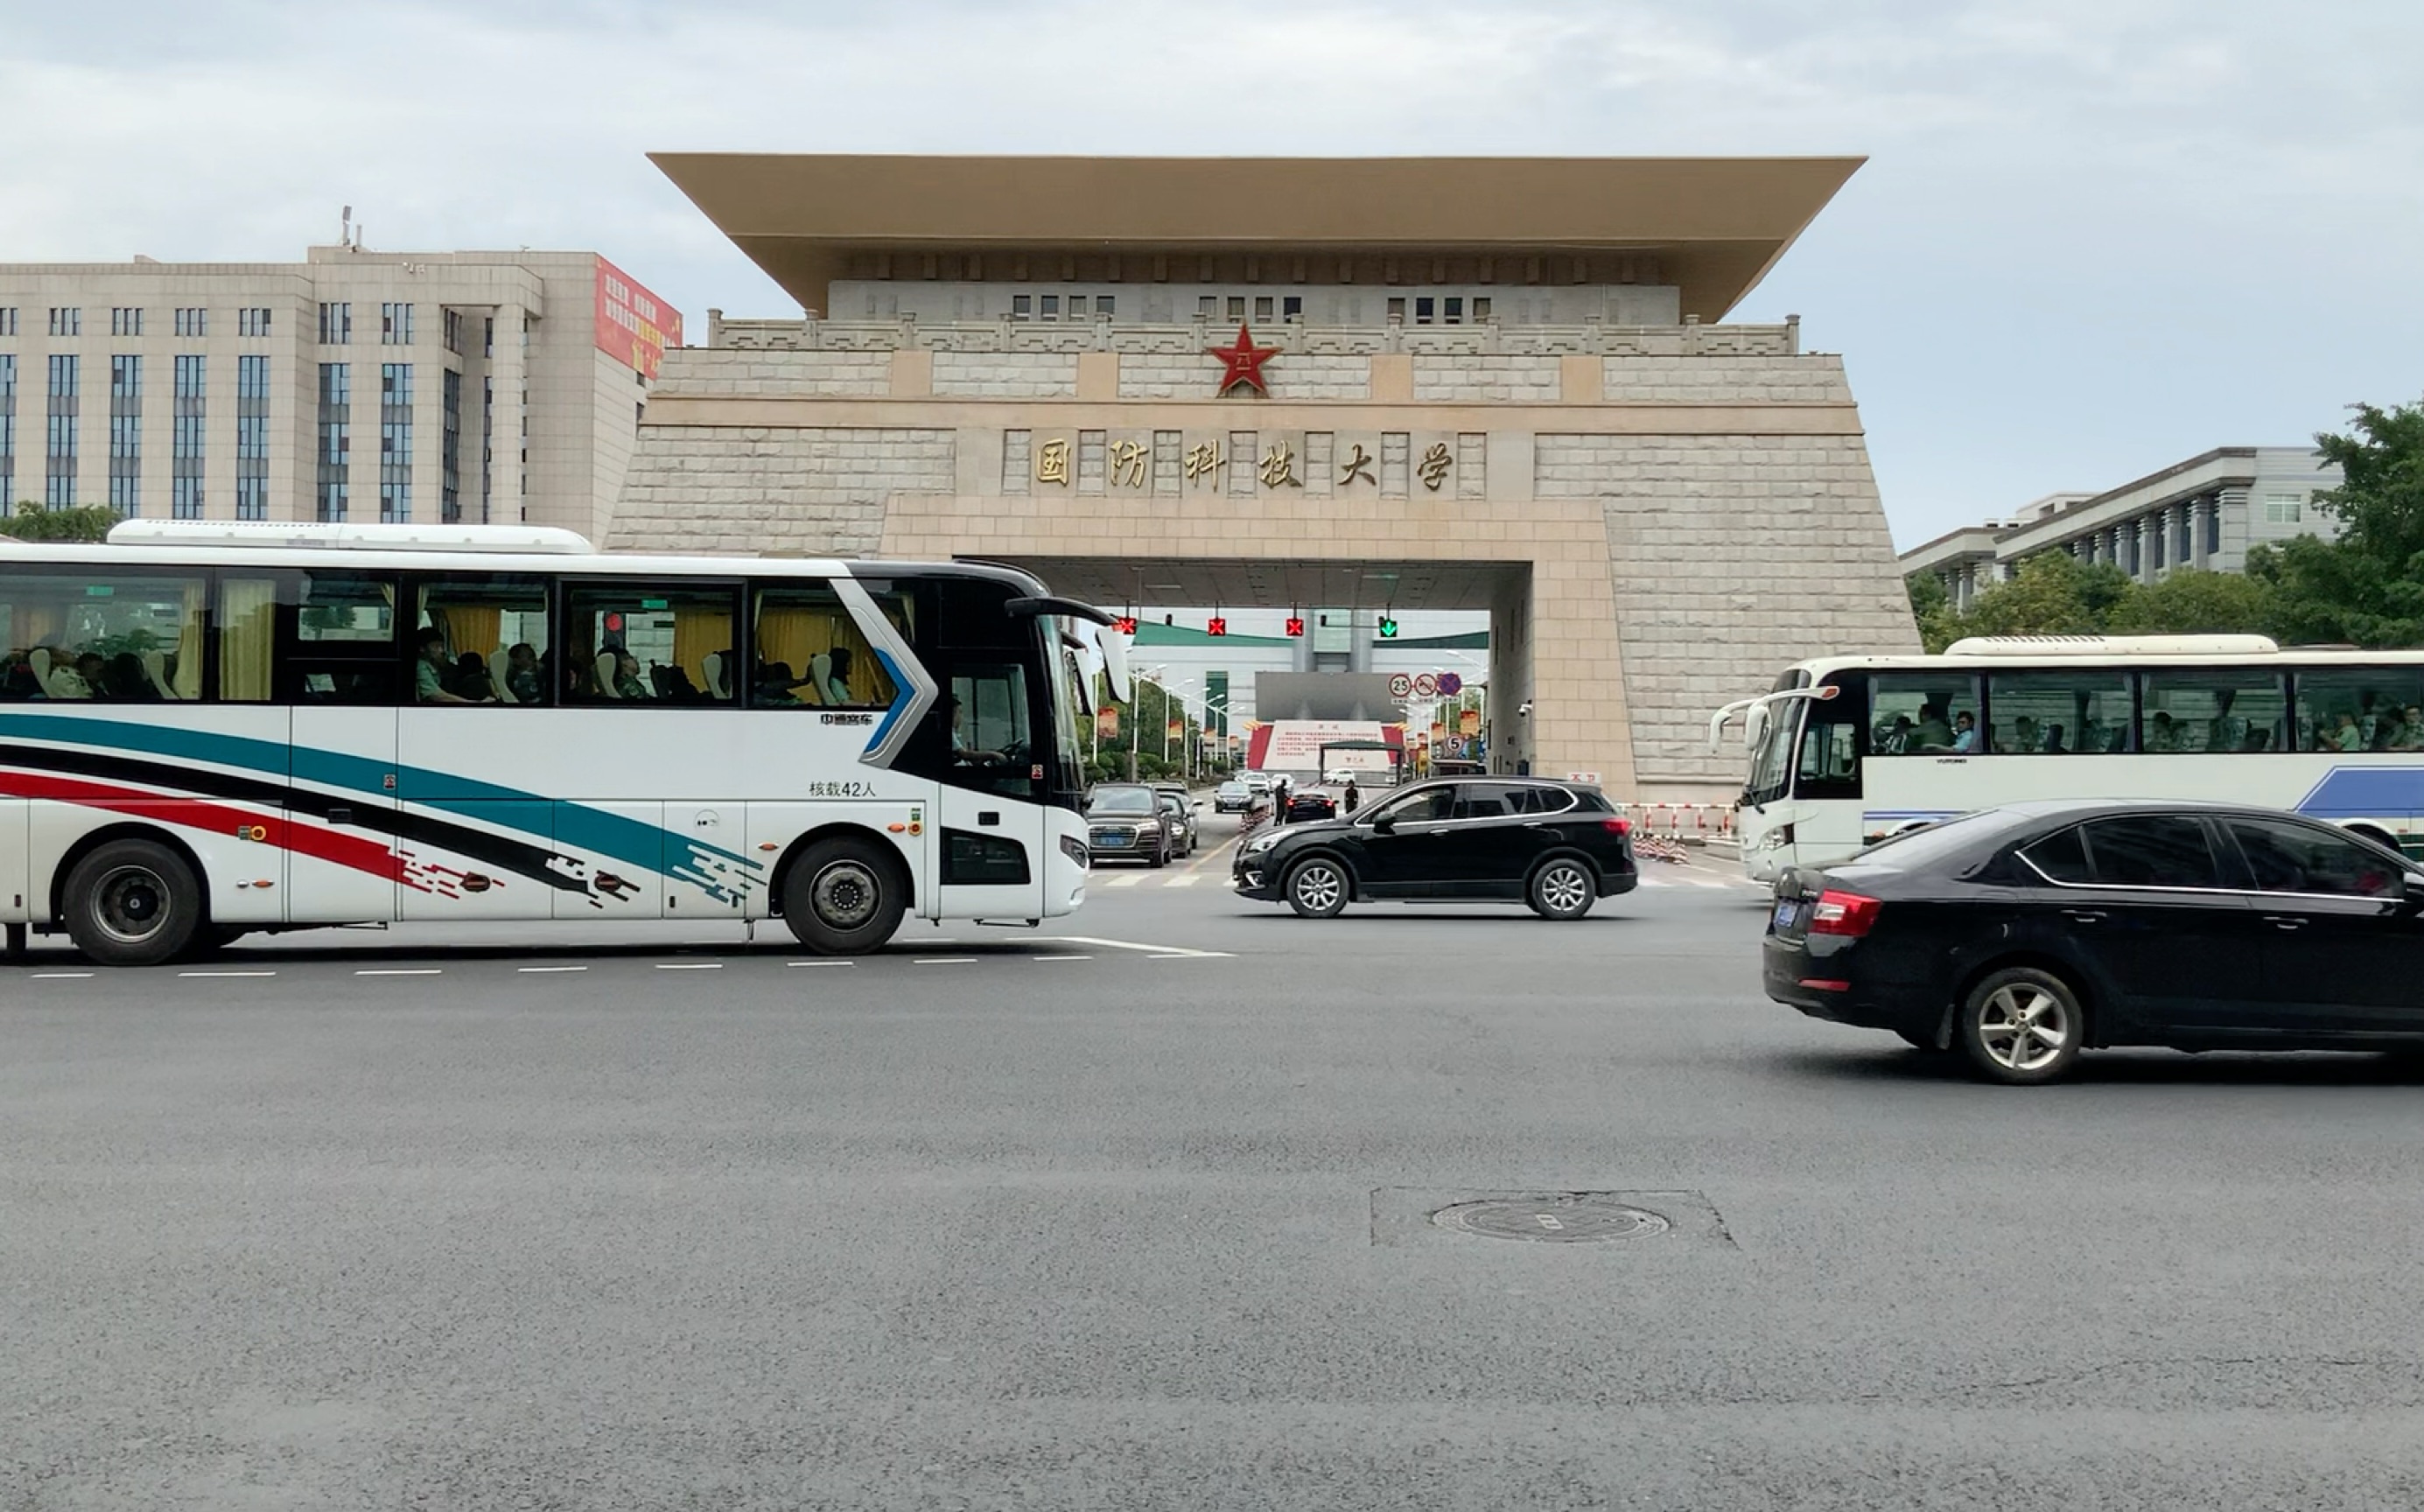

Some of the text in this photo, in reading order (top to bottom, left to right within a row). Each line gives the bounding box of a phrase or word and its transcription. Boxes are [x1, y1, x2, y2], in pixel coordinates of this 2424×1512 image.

[1035, 438, 1454, 492] 国防科技大学
[1394, 680, 1408, 691] 25
[1451, 738, 1460, 750] 5
[809, 781, 876, 797] 核载42人
